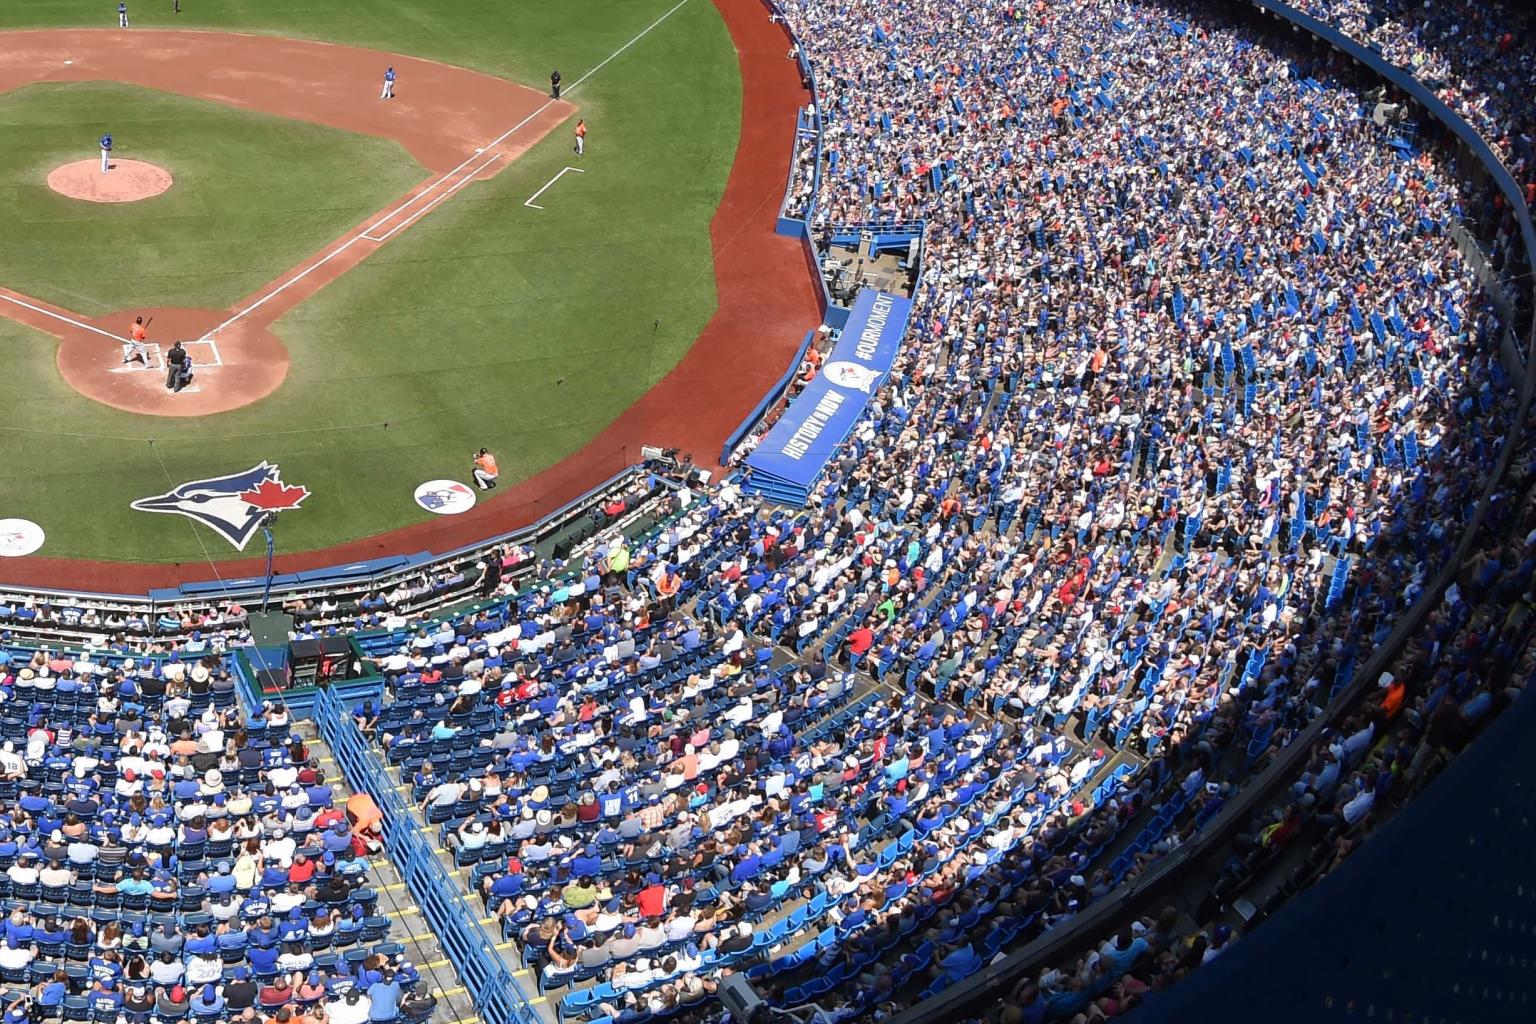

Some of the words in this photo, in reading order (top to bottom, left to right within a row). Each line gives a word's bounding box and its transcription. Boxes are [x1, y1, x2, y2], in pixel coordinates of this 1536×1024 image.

[854, 292, 894, 361] #OURMOMENT
[781, 416, 824, 460] HISTORY
[822, 389, 846, 417] NOW
